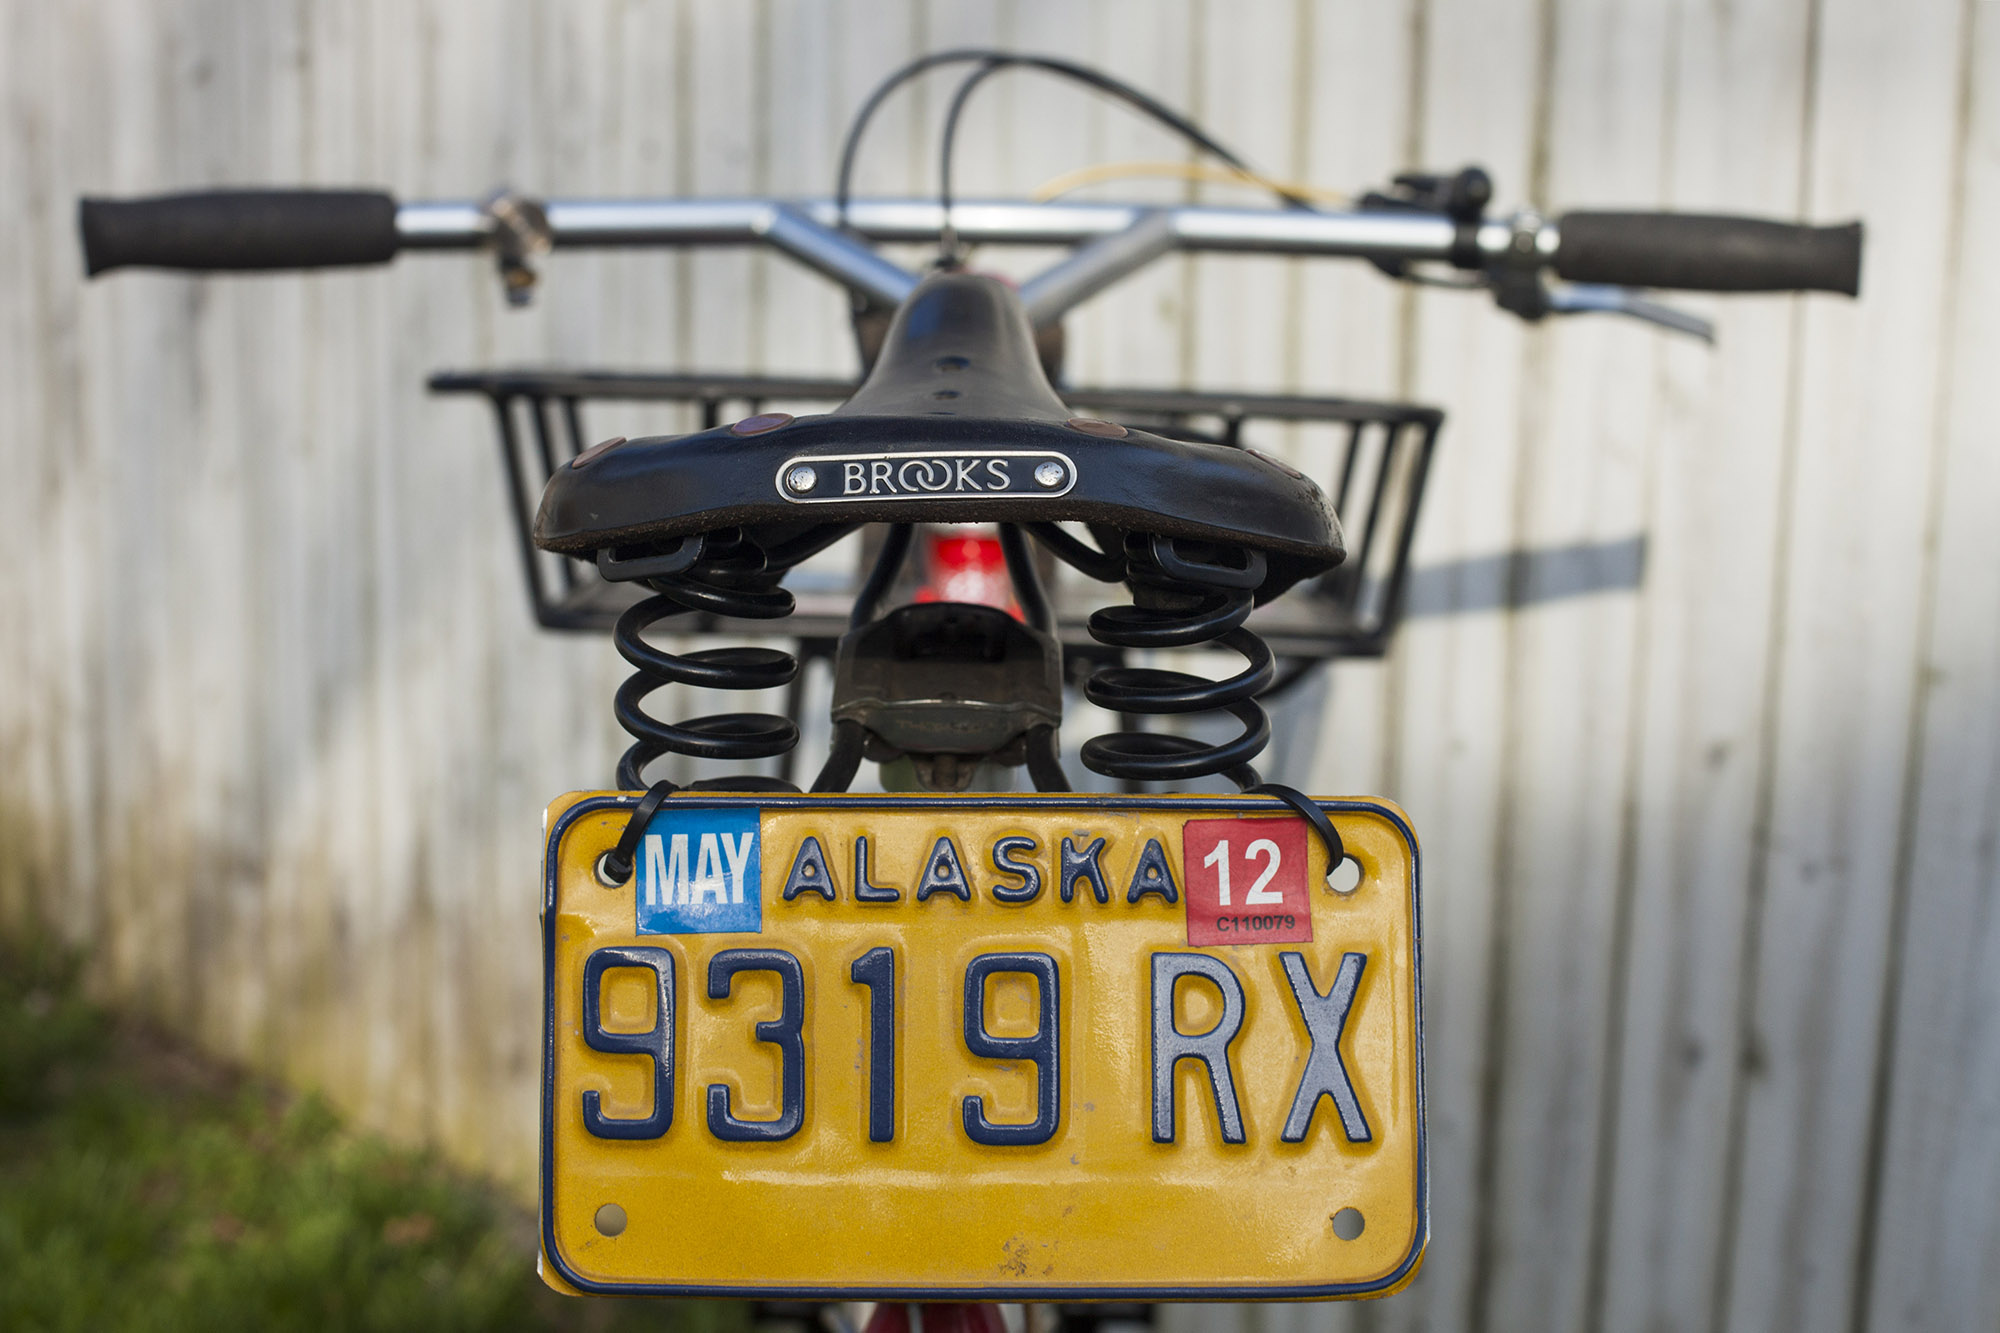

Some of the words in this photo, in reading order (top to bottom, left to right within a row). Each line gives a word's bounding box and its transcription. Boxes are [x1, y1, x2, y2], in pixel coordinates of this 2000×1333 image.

[843, 459, 1011, 495] BROOKS
[645, 833, 754, 905] MAY
[782, 836, 1179, 903] ALASKA
[1204, 838, 1283, 906] 12
[1216, 914, 1295, 932] C110079
[582, 946, 1060, 1146] 9319
[1150, 951, 1373, 1144] RX
